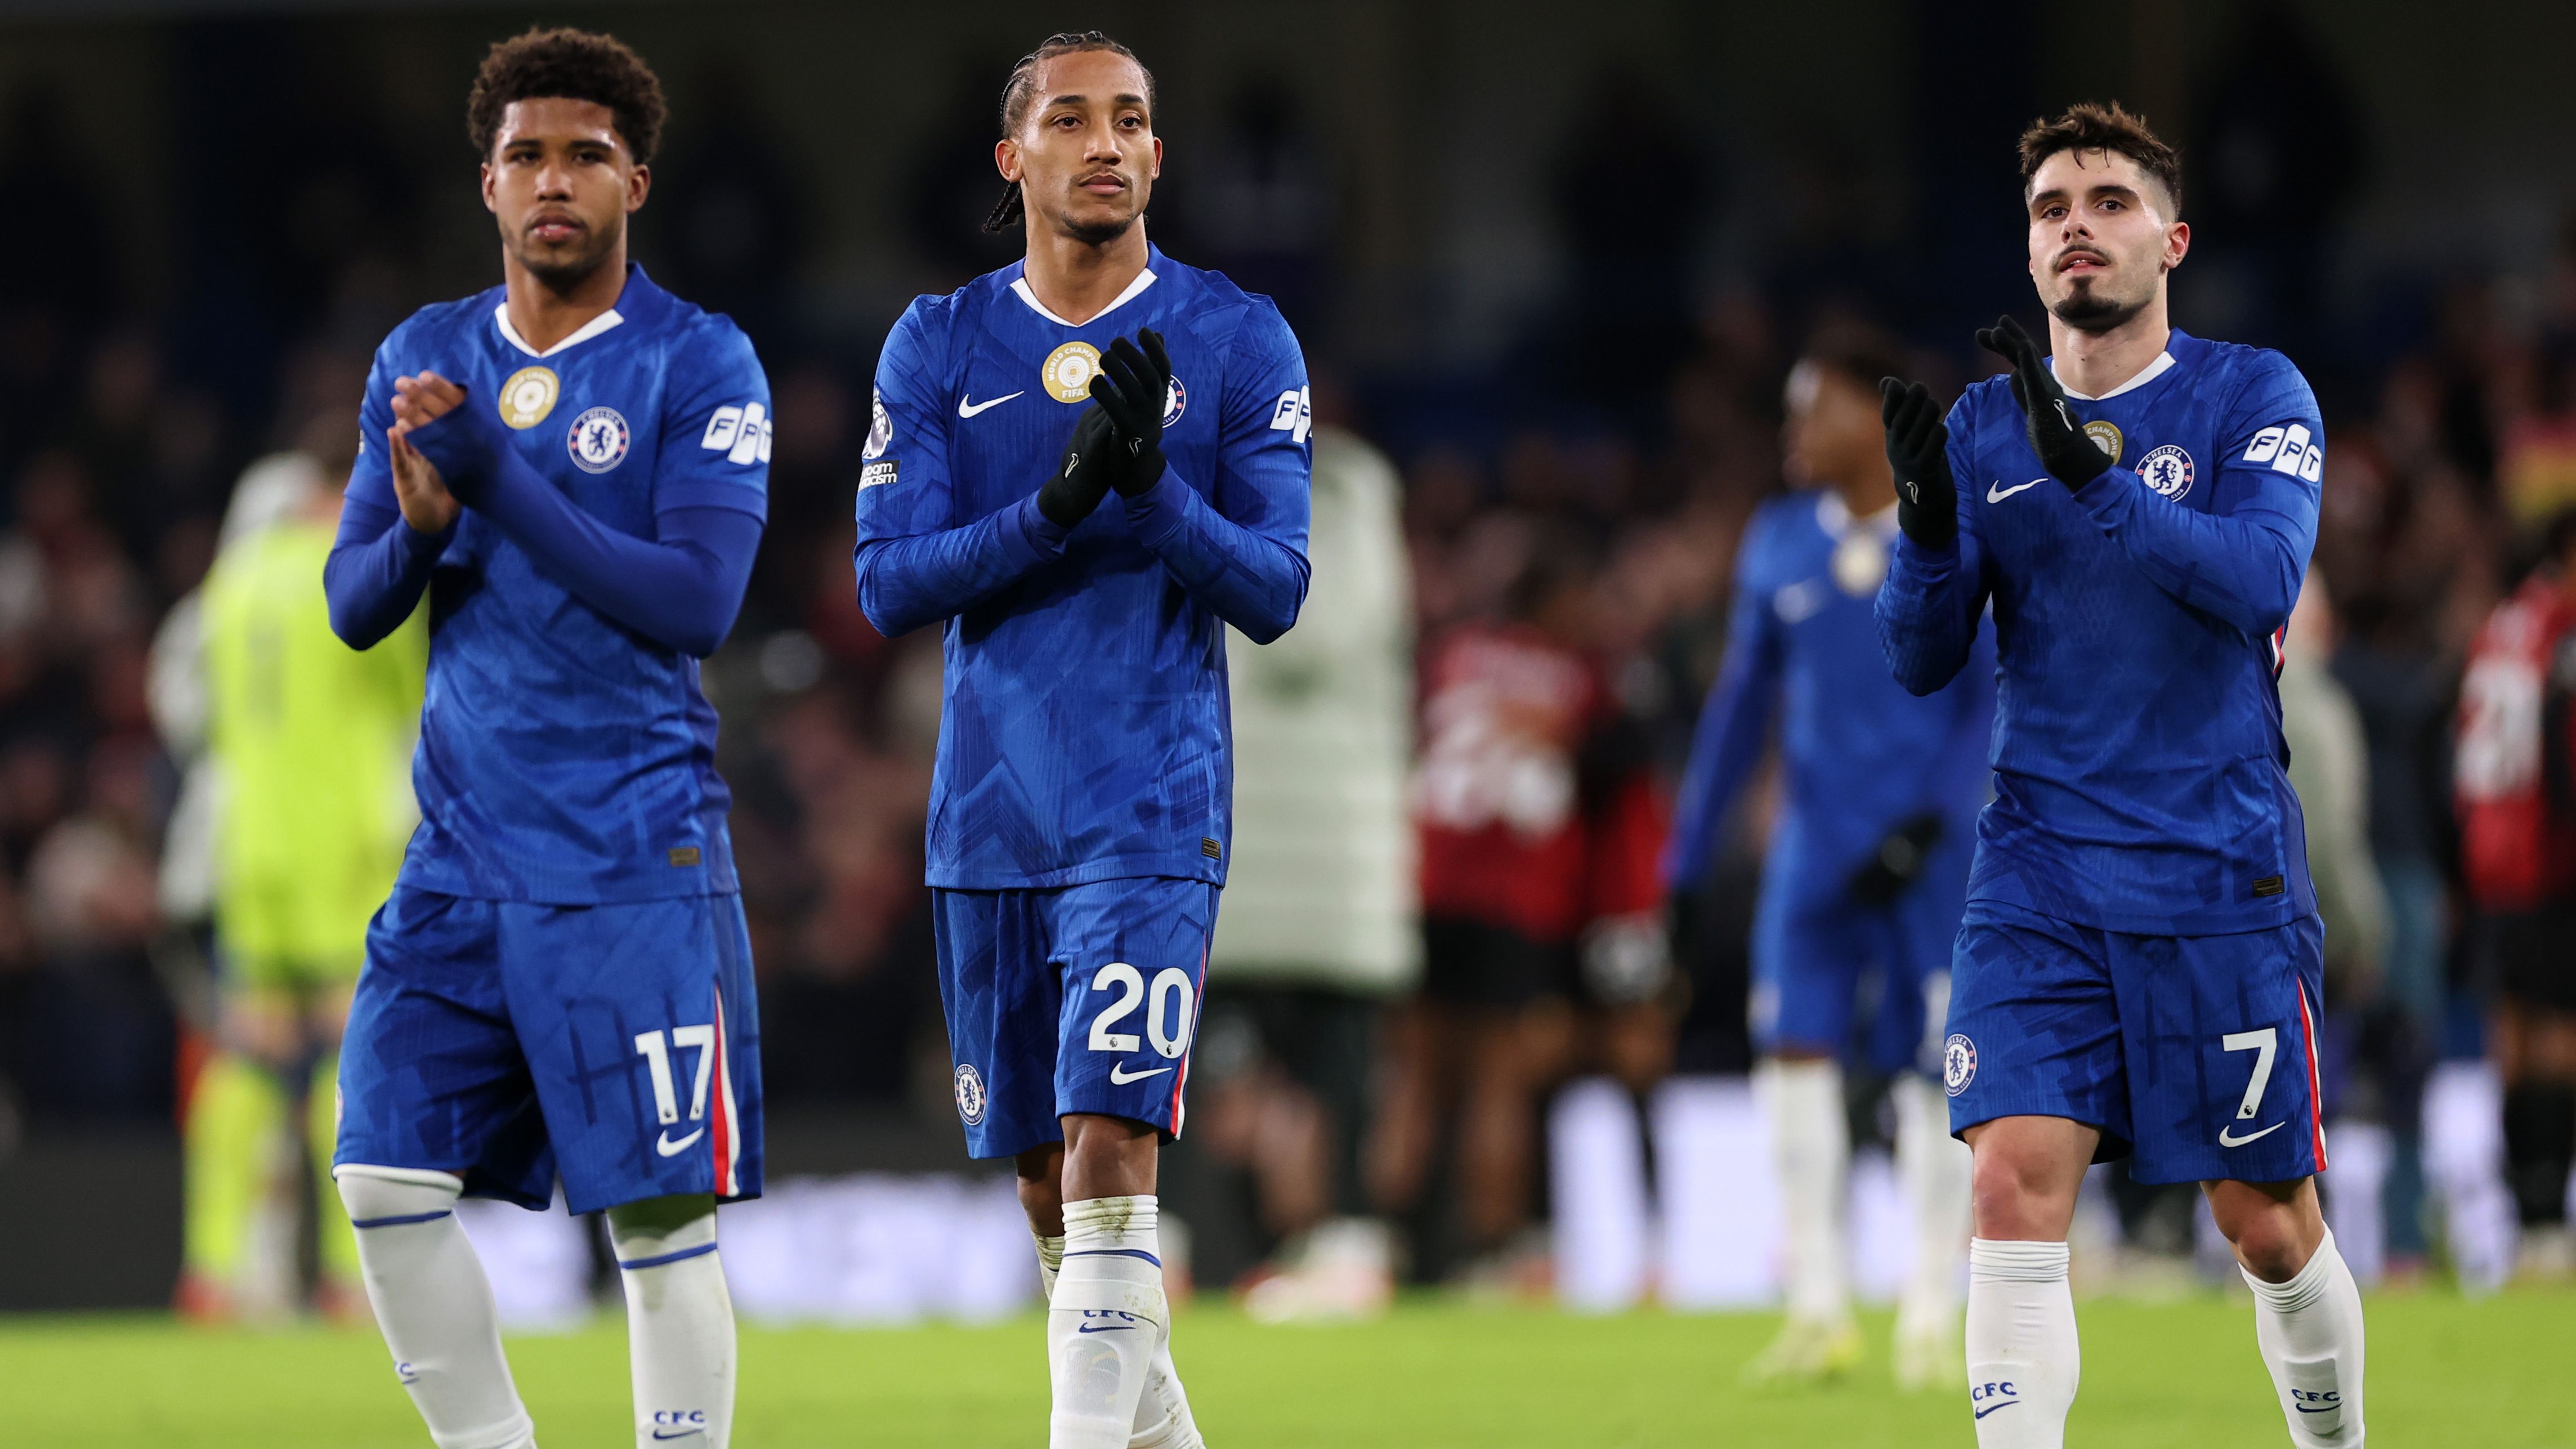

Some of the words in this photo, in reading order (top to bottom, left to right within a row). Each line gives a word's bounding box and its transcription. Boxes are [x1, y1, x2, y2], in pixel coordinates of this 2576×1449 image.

[1048, 352, 1063, 382] WORLD
[1062, 388, 1085, 398] FIFA
[2087, 426, 2117, 455] CHAMPIONS
[2145, 447, 2182, 463] CHELSEA
[2249, 433, 2320, 474] FPT
[2171, 488, 2184, 499] CLUB
[1088, 962, 1195, 1059] 20
[634, 1023, 715, 1126] 17
[957, 1066, 976, 1079] CHELSEA
[2222, 1027, 2277, 1120] 7
[1972, 1381, 2017, 1401] CFC
[2291, 1389, 2341, 1402] CFC
[654, 1410, 706, 1425] CFC
